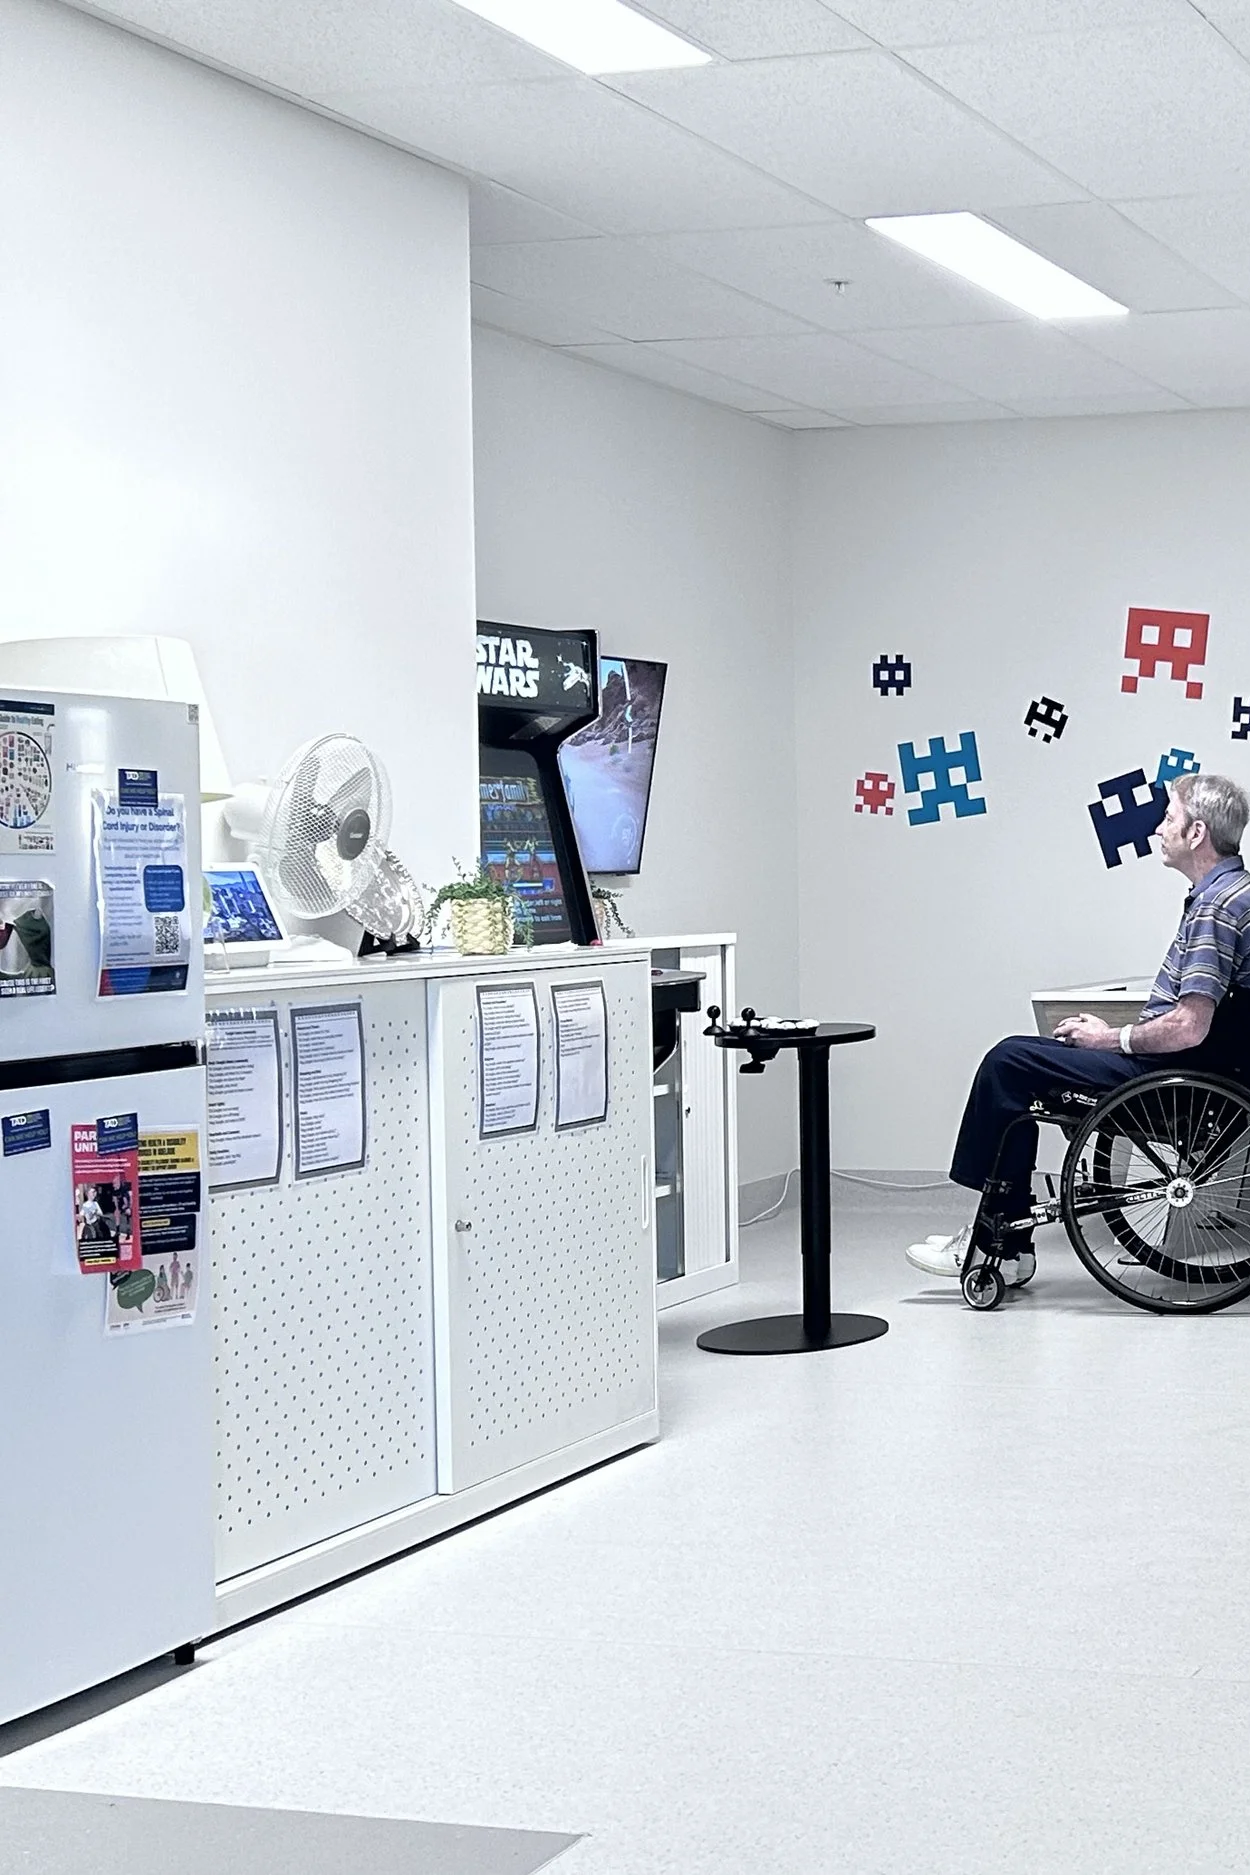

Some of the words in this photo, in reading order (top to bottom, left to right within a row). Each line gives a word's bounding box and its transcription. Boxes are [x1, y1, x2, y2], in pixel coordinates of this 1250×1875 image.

[476, 635, 539, 668] STAR
[154, 807, 175, 817] Spinal
[120, 822, 139, 832] Injury
[74, 1131, 97, 1141] PAR
